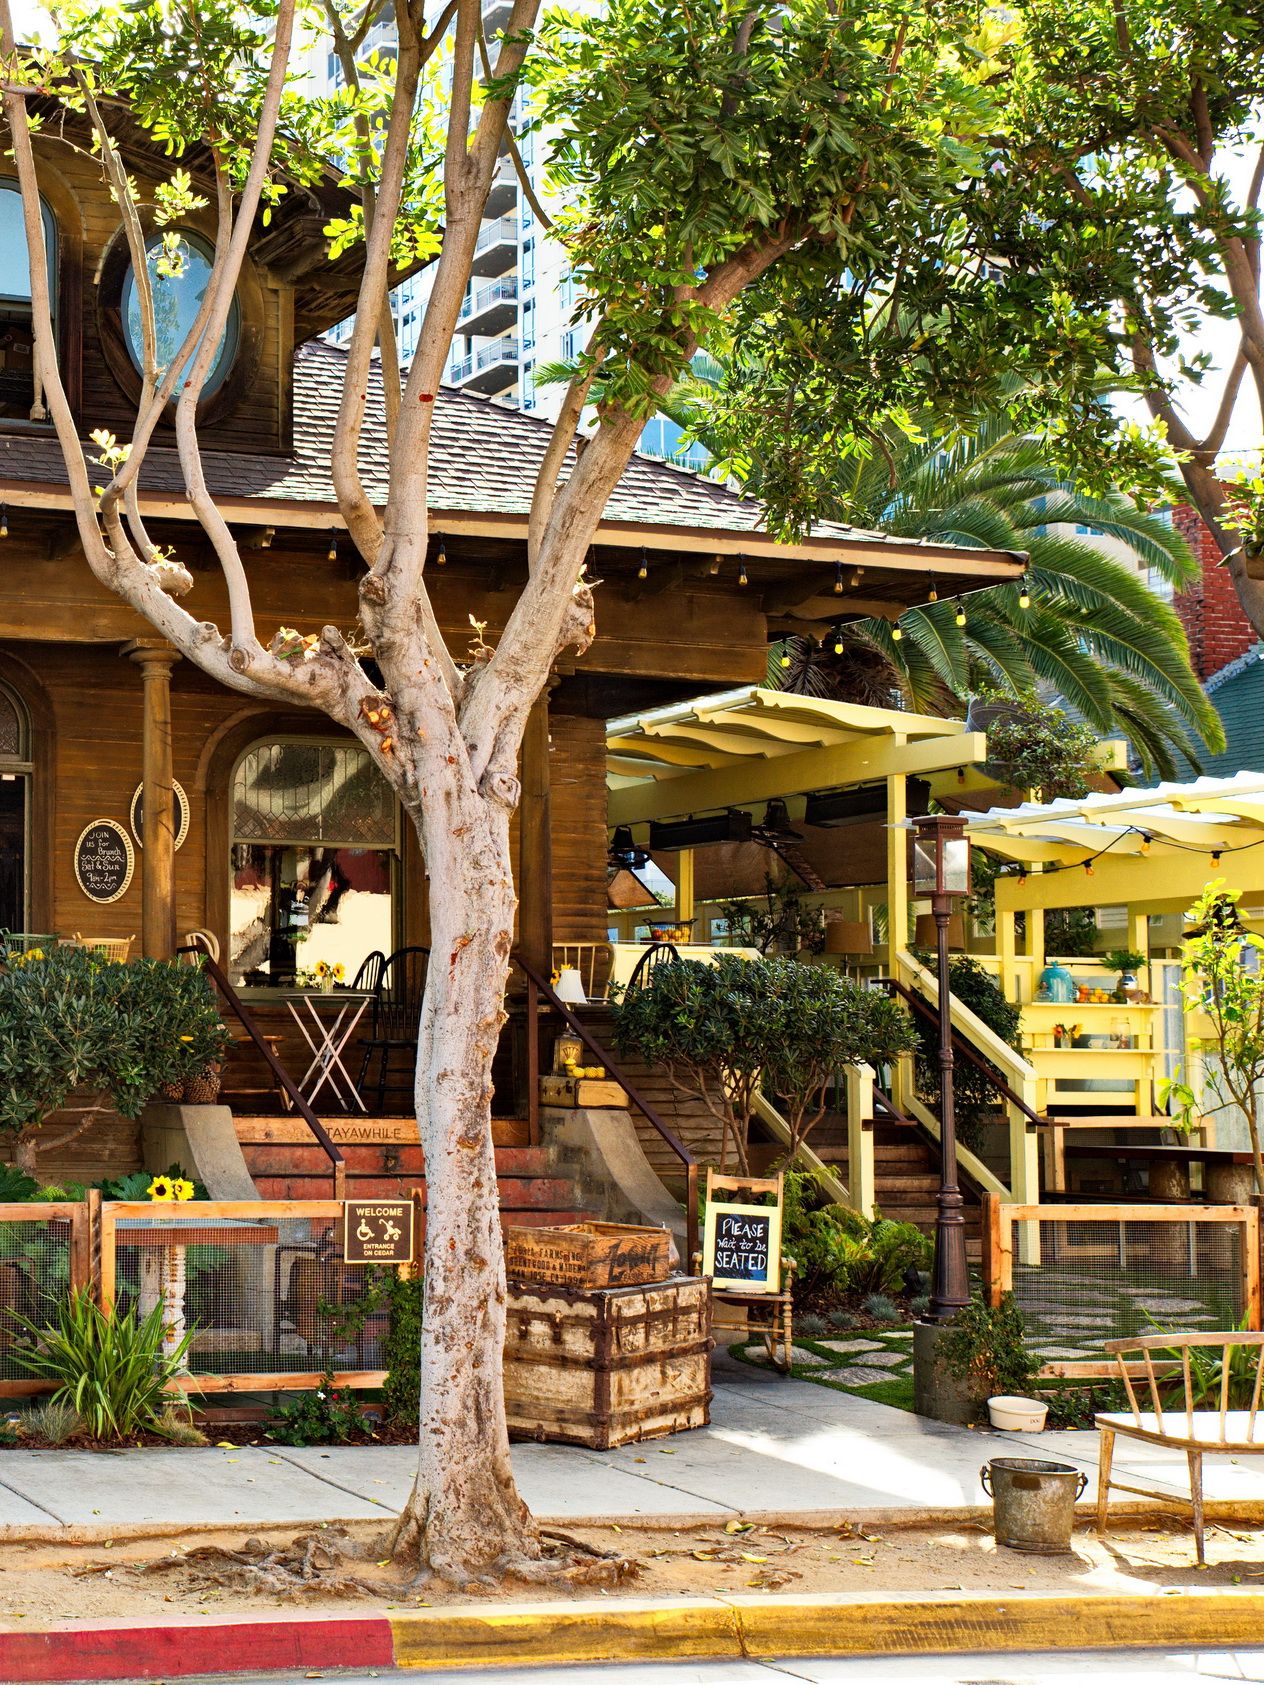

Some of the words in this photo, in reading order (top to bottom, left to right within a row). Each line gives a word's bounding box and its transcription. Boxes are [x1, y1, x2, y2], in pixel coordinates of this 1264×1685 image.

[325, 1127, 402, 1140] TAYAWHILE
[356, 1207, 403, 1217] WELCOME
[739, 1238, 753, 1250] to
[754, 1240, 767, 1252] be
[715, 1251, 767, 1271] SEATED
